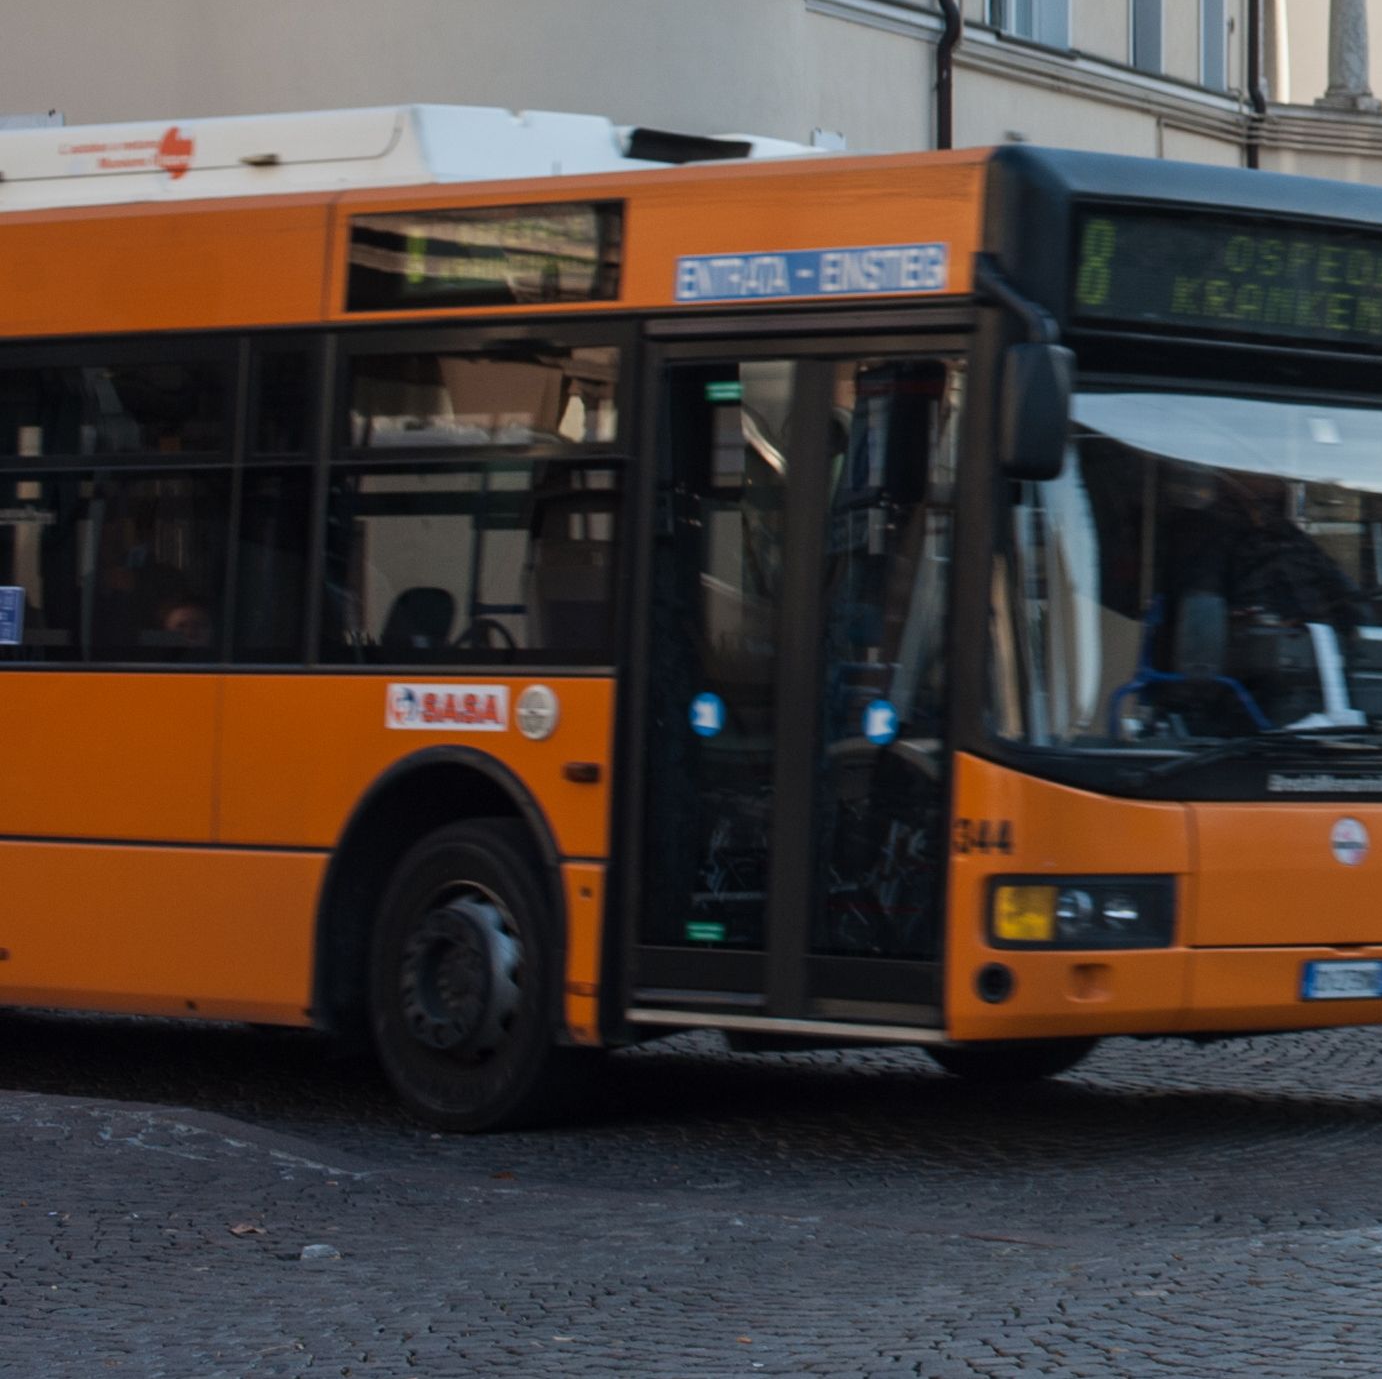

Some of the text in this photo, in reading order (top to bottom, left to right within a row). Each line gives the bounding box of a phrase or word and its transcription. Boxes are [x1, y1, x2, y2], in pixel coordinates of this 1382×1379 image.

[1076, 218, 1117, 306] 8
[421, 692, 502, 724] SASA
[950, 817, 1016, 856] 344
